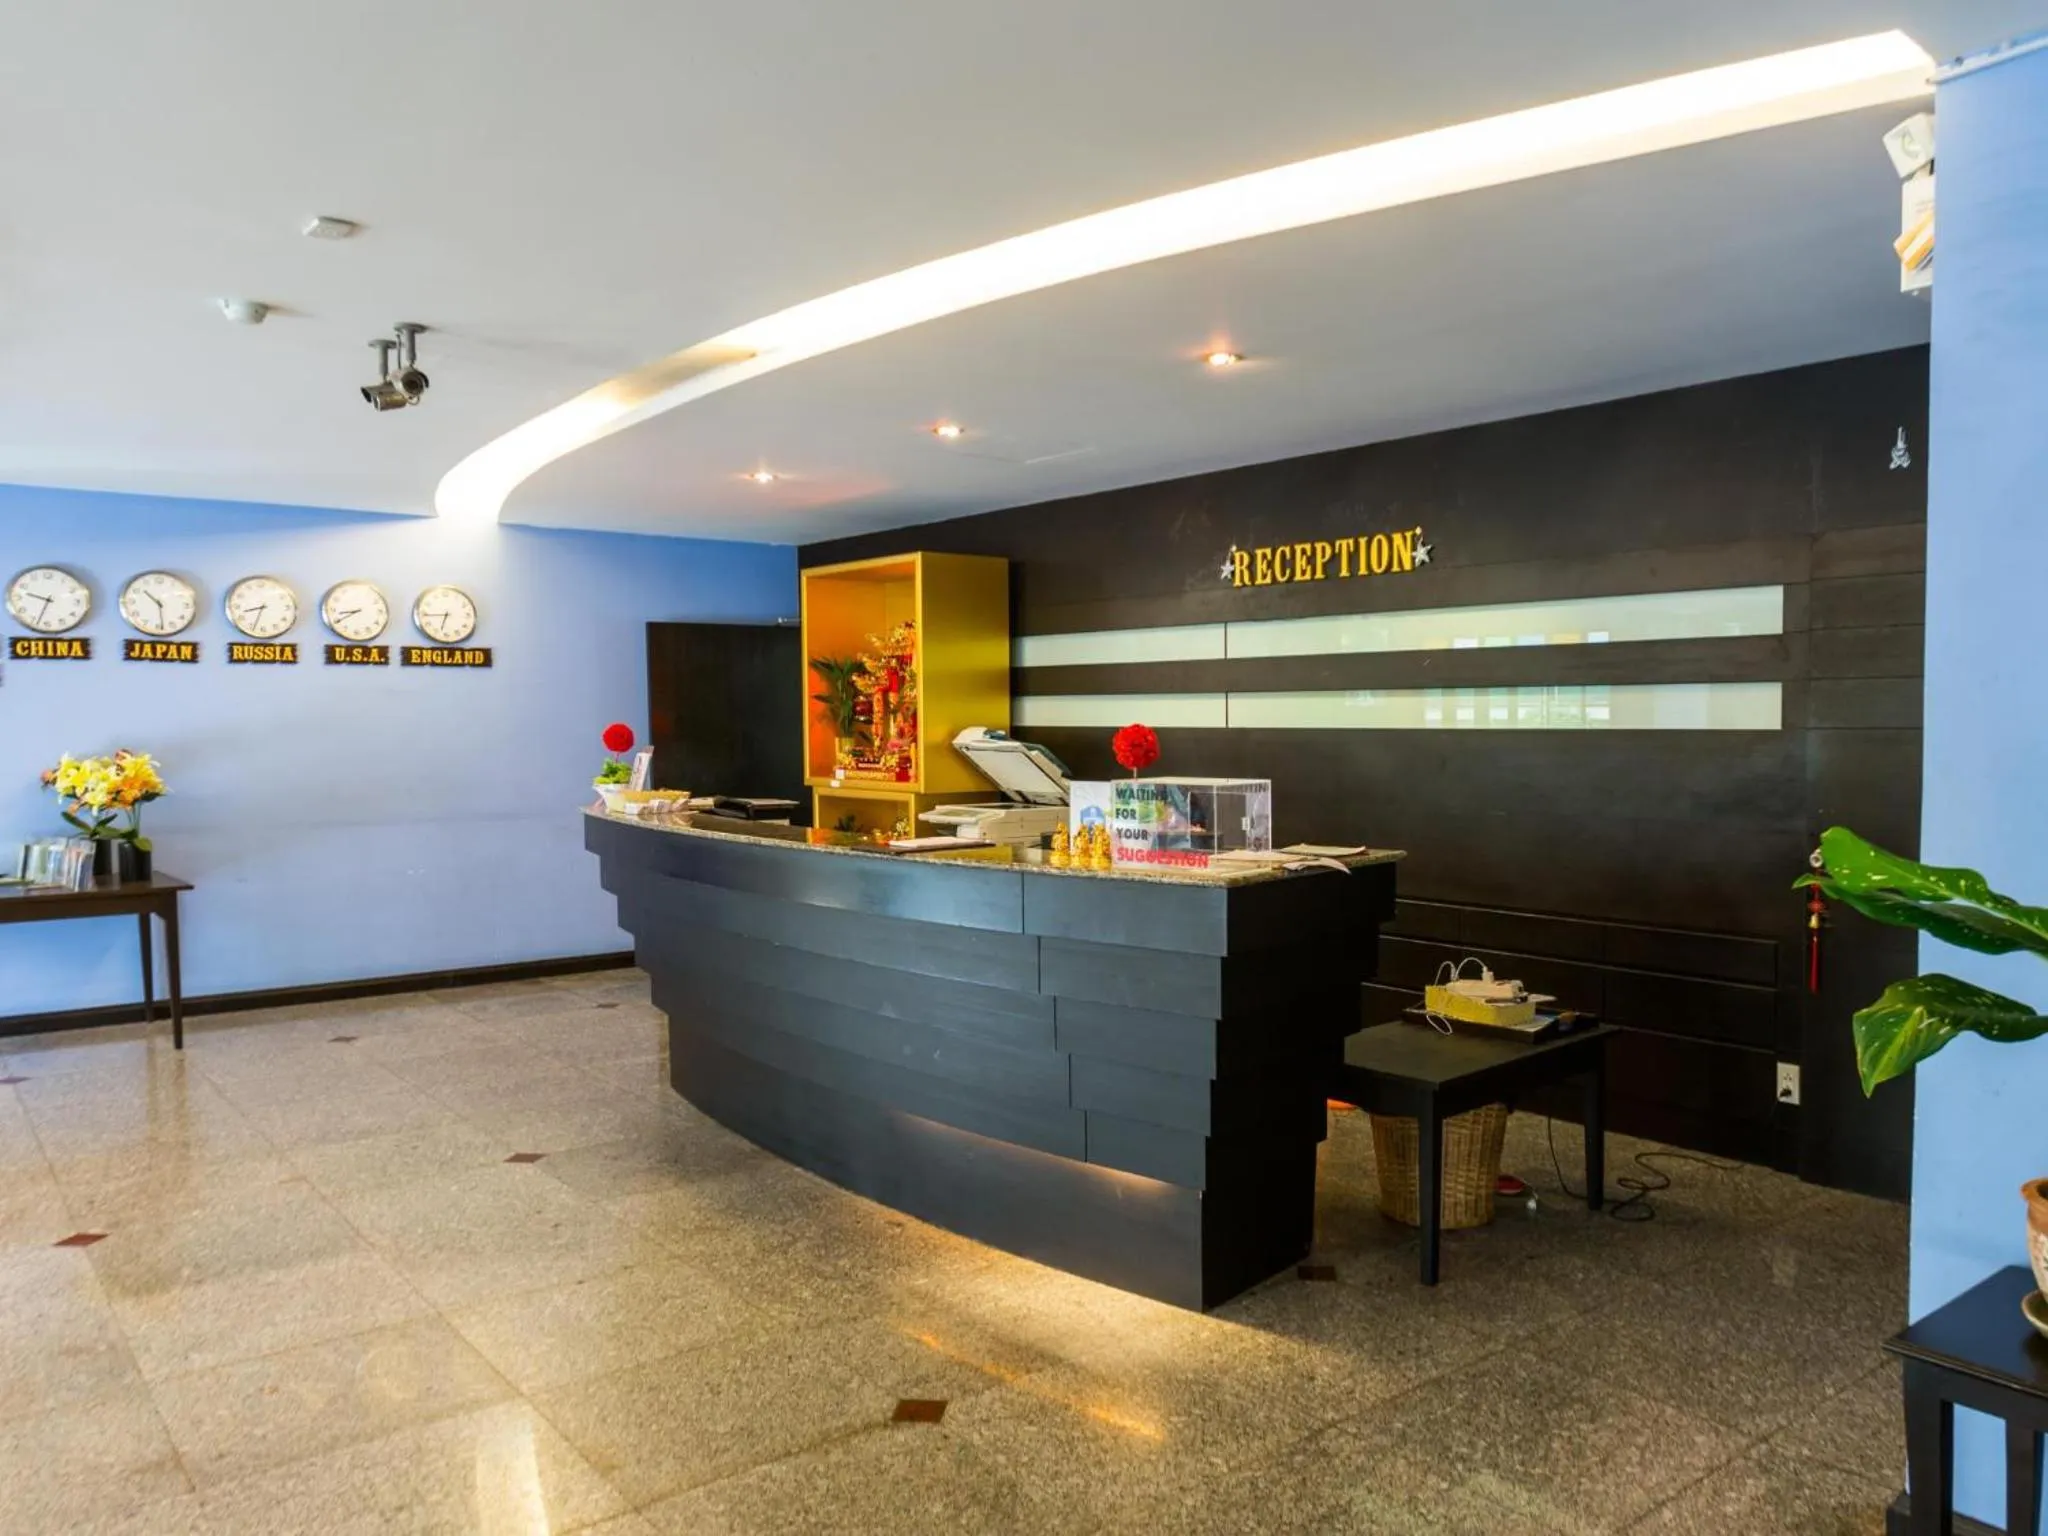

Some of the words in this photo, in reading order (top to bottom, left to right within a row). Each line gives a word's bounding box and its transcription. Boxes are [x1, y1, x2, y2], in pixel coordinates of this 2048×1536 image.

[1234, 531, 1415, 586] RECEPTION
[15, 640, 84, 657] CHINA
[129, 642, 193, 660] JAPAN
[232, 645, 294, 662] RUSSIA
[335, 647, 386, 662] U.S.A.
[411, 649, 485, 665] ENGLAND
[1115, 788, 1168, 801] WAITING
[1115, 808, 1137, 820] FOR
[1116, 828, 1149, 841] YOUR
